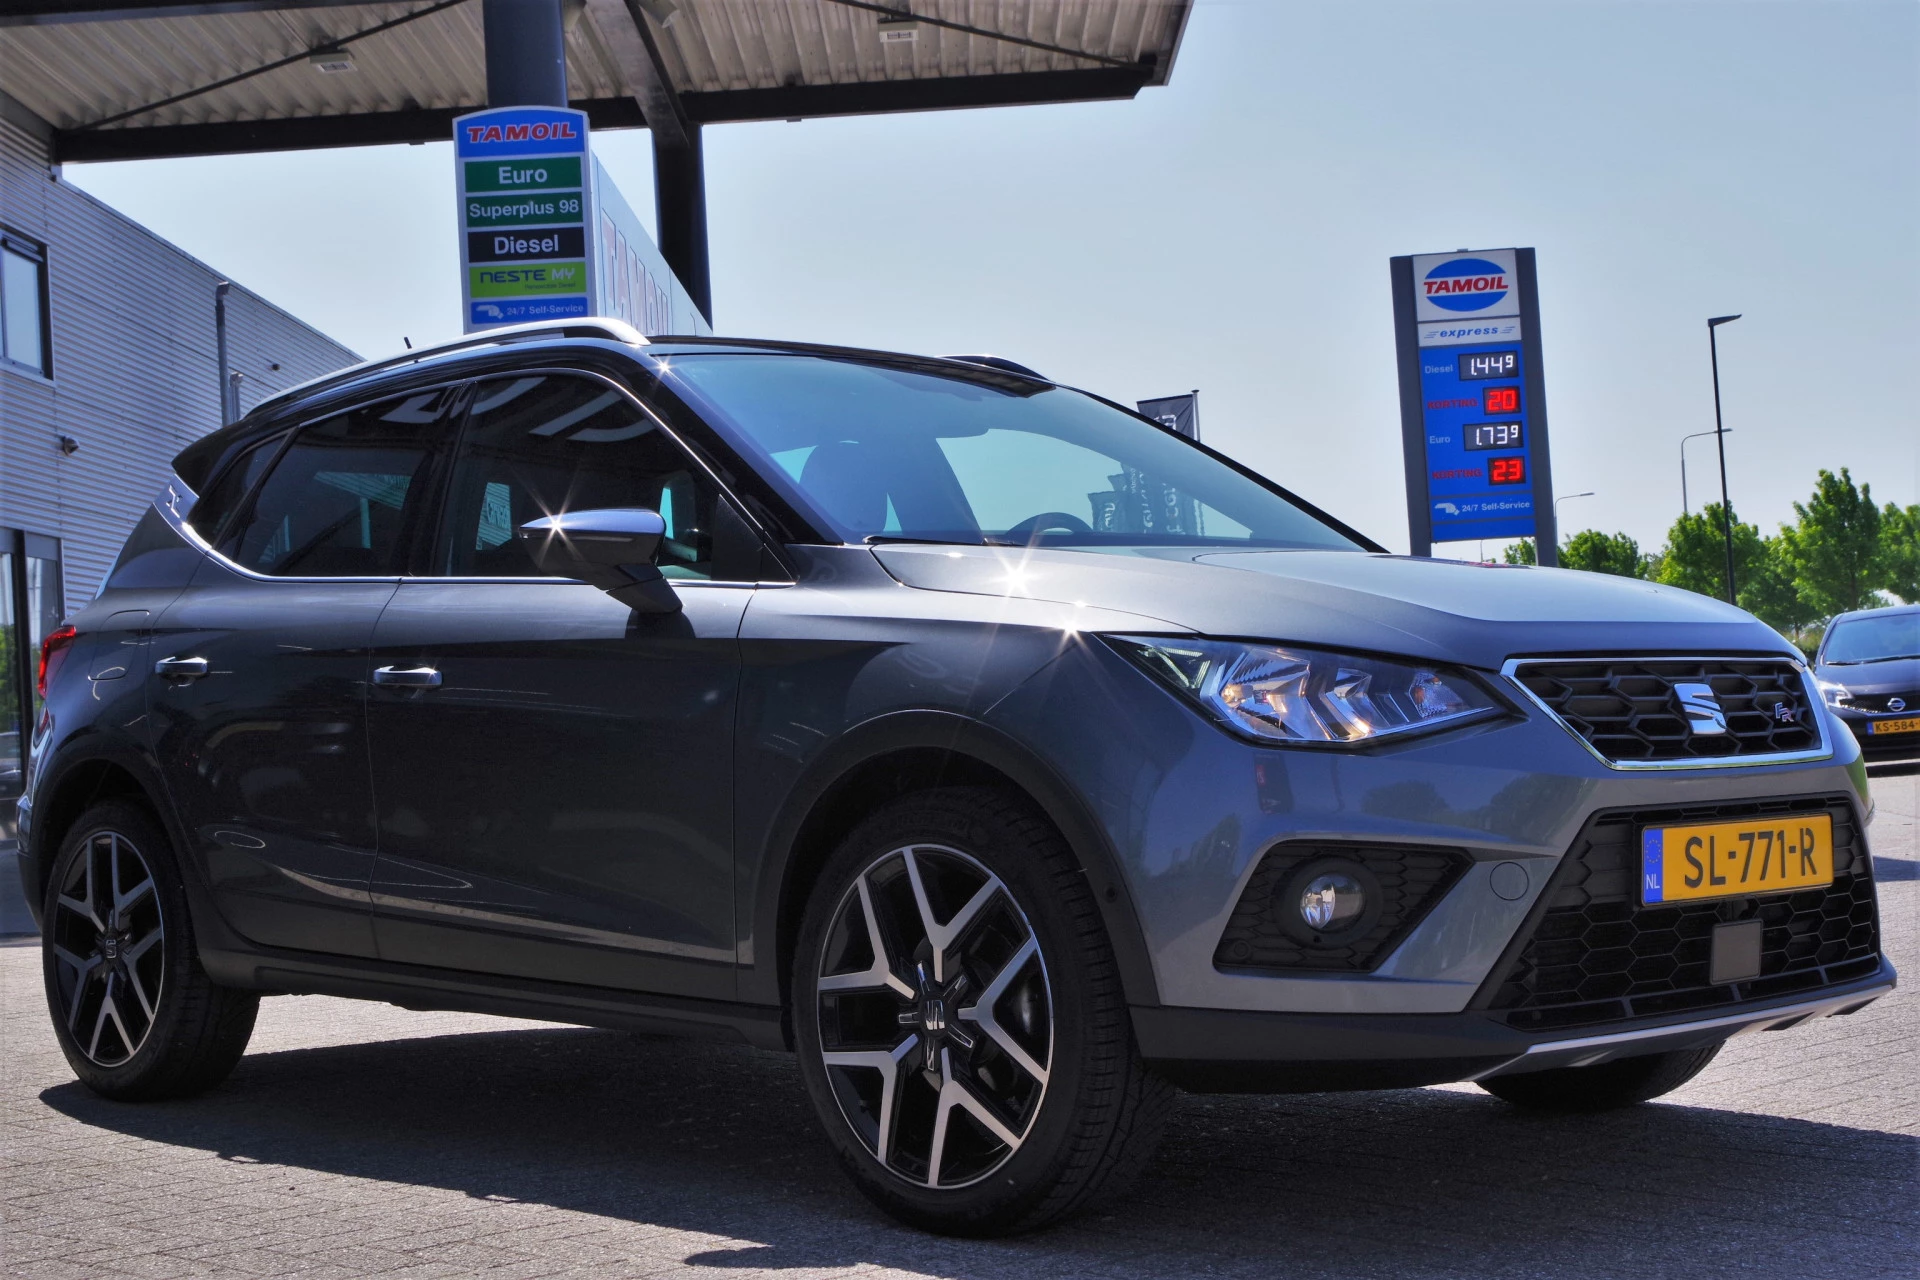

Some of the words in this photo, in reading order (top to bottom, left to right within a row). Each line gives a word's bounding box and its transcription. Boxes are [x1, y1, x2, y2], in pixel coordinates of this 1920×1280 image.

[467, 123, 576, 143] TAMOIL
[499, 167, 547, 184] Euro
[469, 201, 554, 219] Superplus
[560, 200, 579, 213] 98
[495, 235, 558, 254] Diesel
[551, 268, 575, 280] MY
[1423, 277, 1508, 294] TAMOIL
[506, 307, 525, 316] 24/7
[529, 304, 584, 315] Self-Service
[1440, 326, 1499, 338] express
[1424, 364, 1454, 374] Diesel
[1428, 398, 1478, 409] KORTING
[1487, 389, 1517, 411] 20
[1429, 436, 1450, 444] Euro
[1432, 468, 1483, 479] KORTING
[1493, 459, 1522, 482] 23
[1462, 504, 1478, 512] 24/7
[1481, 501, 1530, 511] Self-Service
[1875, 720, 1920, 732] KS-584-
[1646, 873, 1660, 889] NL
[1684, 827, 1817, 888] SL-771-R
